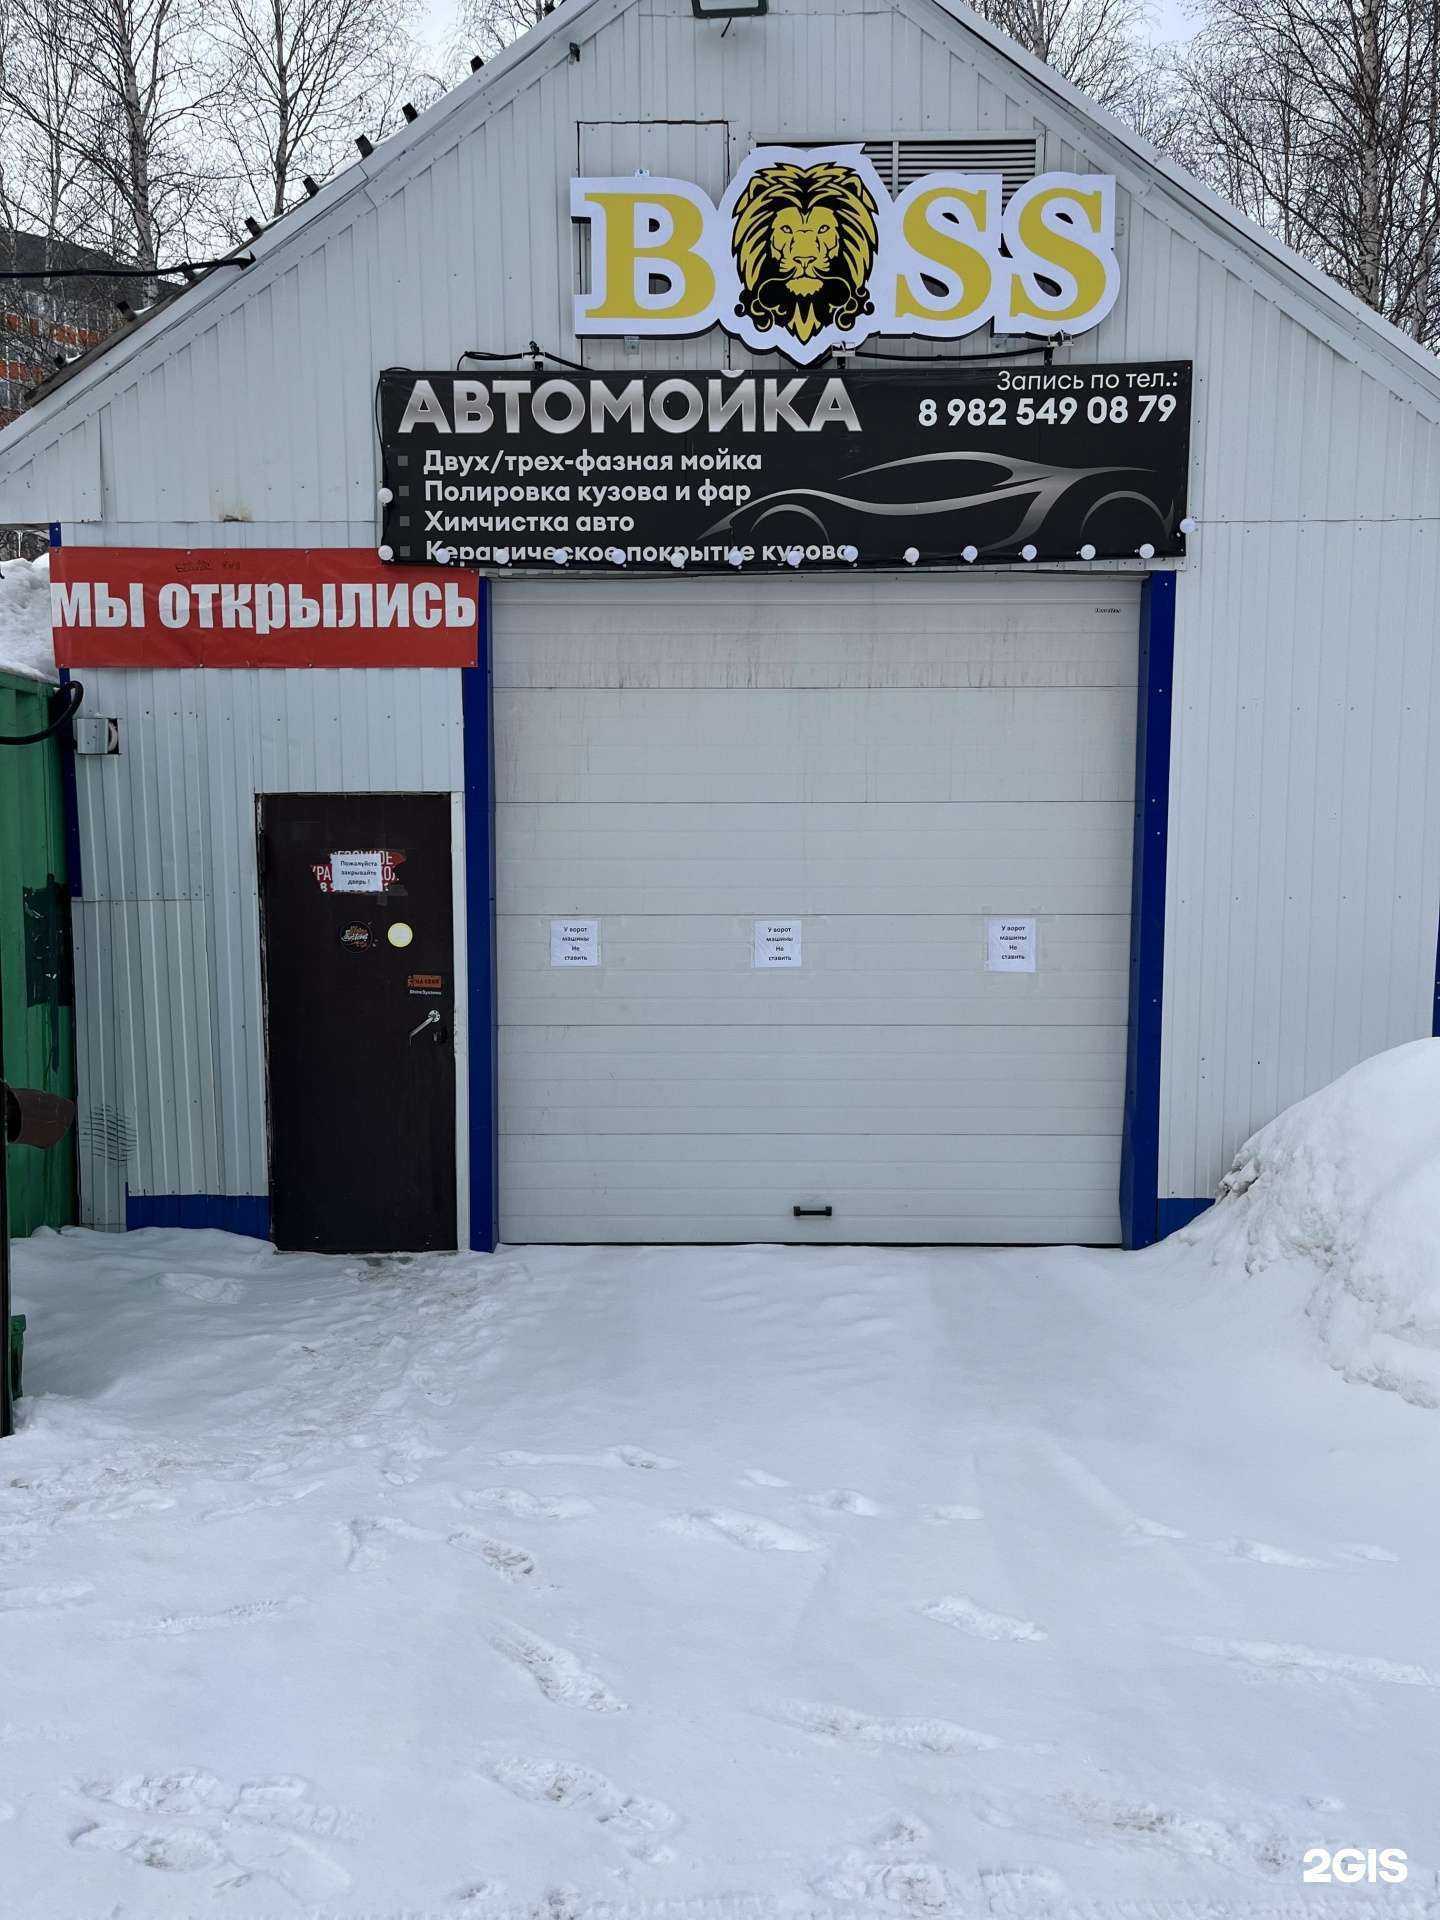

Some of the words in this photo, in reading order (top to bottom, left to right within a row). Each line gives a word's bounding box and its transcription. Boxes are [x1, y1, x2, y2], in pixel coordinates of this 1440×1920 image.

[585, 187, 1107, 322] BSS
[997, 370, 1084, 392] Запись
[1090, 375, 1119, 389] по
[1125, 371, 1179, 388] тел.:
[398, 371, 863, 434] АВТОМОЙКА
[918, 399, 938, 427] 8
[947, 398, 1007, 427] 982
[1016, 397, 1078, 426] 549
[1086, 396, 1129, 424] 08
[1138, 394, 1177, 423] 79
[423, 449, 673, 476] Двух/трех-фазная
[681, 448, 762, 471] мойка
[424, 480, 570, 506] Полировка
[578, 484, 668, 506] кузова
[675, 484, 690, 501] и
[698, 479, 751, 506] фар
[424, 511, 569, 532] Химчистка
[576, 515, 635, 532] авто
